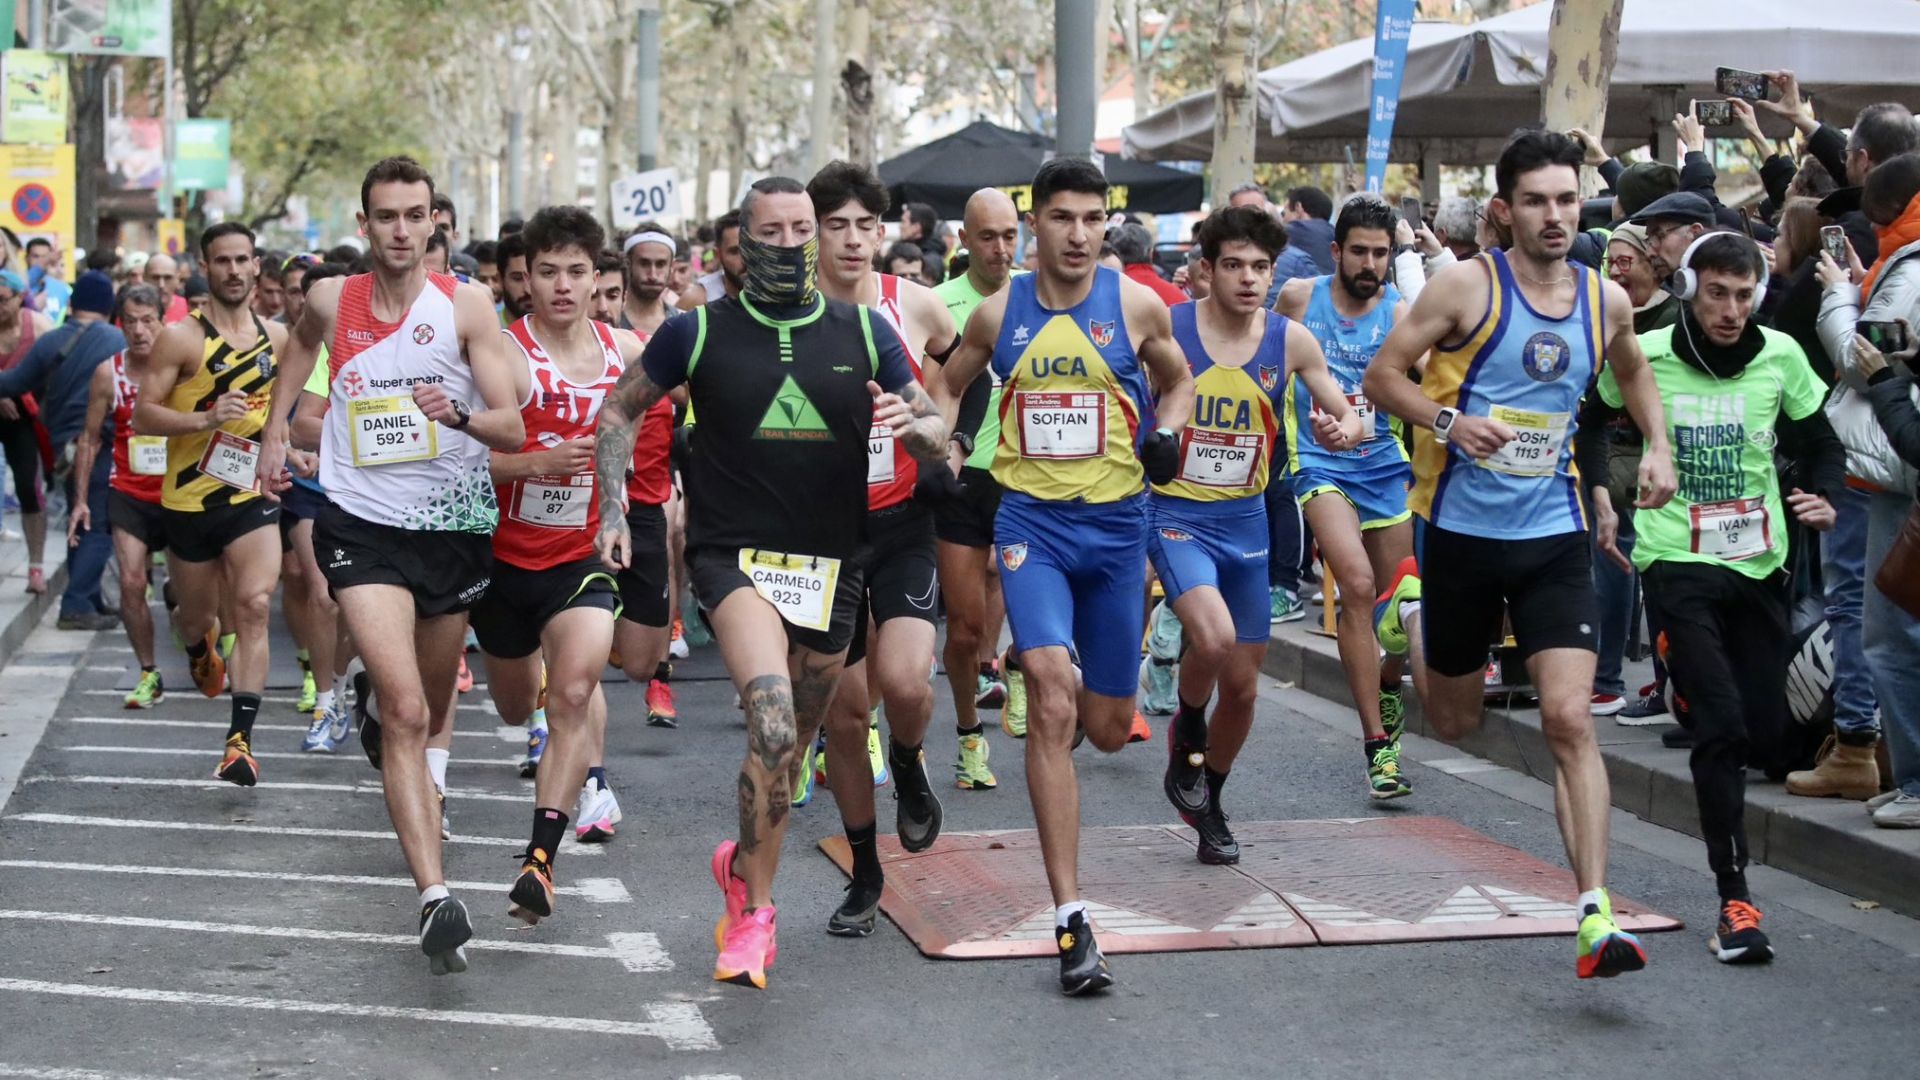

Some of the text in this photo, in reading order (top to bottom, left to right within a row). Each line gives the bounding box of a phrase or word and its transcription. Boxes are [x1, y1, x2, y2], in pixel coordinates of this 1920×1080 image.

[623, 180, 672, 216] -20'
[1325, 348, 1372, 362] BARCELO
[1031, 356, 1088, 378] UCA
[370, 375, 444, 390] super amara
[1032, 413, 1088, 425] SOFIAN
[1195, 394, 1250, 430] UCA
[364, 415, 416, 431] DANIEL
[376, 432, 405, 446] 592
[760, 431, 829, 440] TRAIL MONDAY
[1056, 429, 1062, 440] 1
[1695, 423, 1744, 449] CURSA
[222, 449, 253, 466] DAVID
[1196, 447, 1246, 461] VICTOR
[1515, 446, 1540, 459] 1113
[227, 463, 240, 474] 25
[1214, 462, 1222, 473] 5
[1697, 447, 1744, 476] SANT
[1677, 472, 1745, 501] ANDREU
[543, 489, 572, 501] PAU
[546, 503, 564, 514] 87
[1718, 517, 1750, 531] IVAN
[1726, 533, 1739, 544] 13
[753, 570, 821, 592] CARMELO
[772, 590, 802, 606] 923
